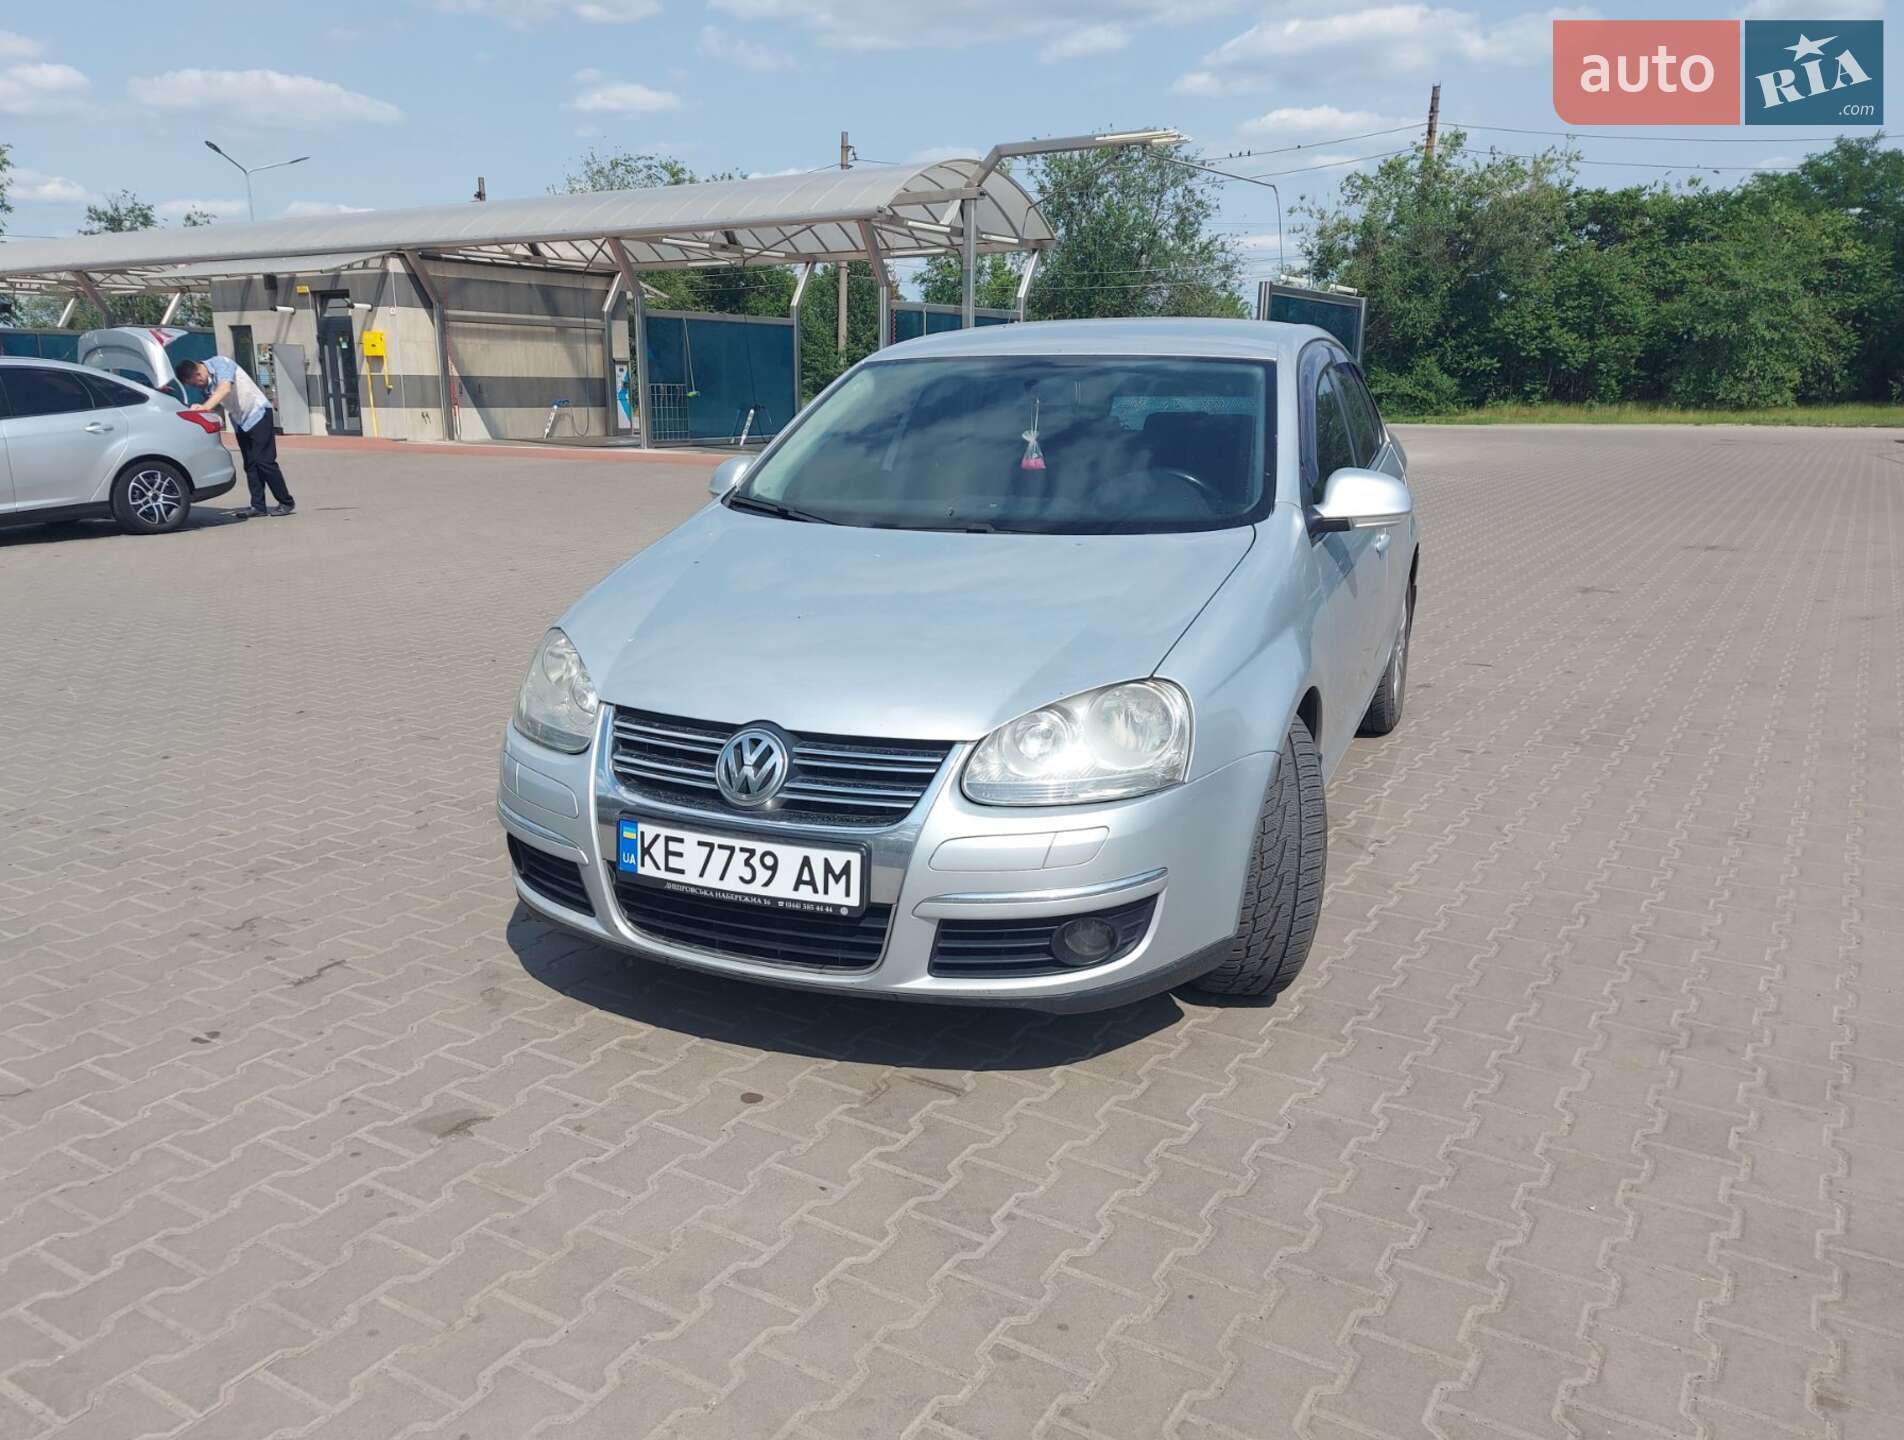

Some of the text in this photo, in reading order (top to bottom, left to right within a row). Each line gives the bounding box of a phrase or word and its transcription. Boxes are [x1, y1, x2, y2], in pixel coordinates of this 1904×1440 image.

[622, 852, 636, 865] UA
[640, 830, 852, 898] KE 7739 AM
